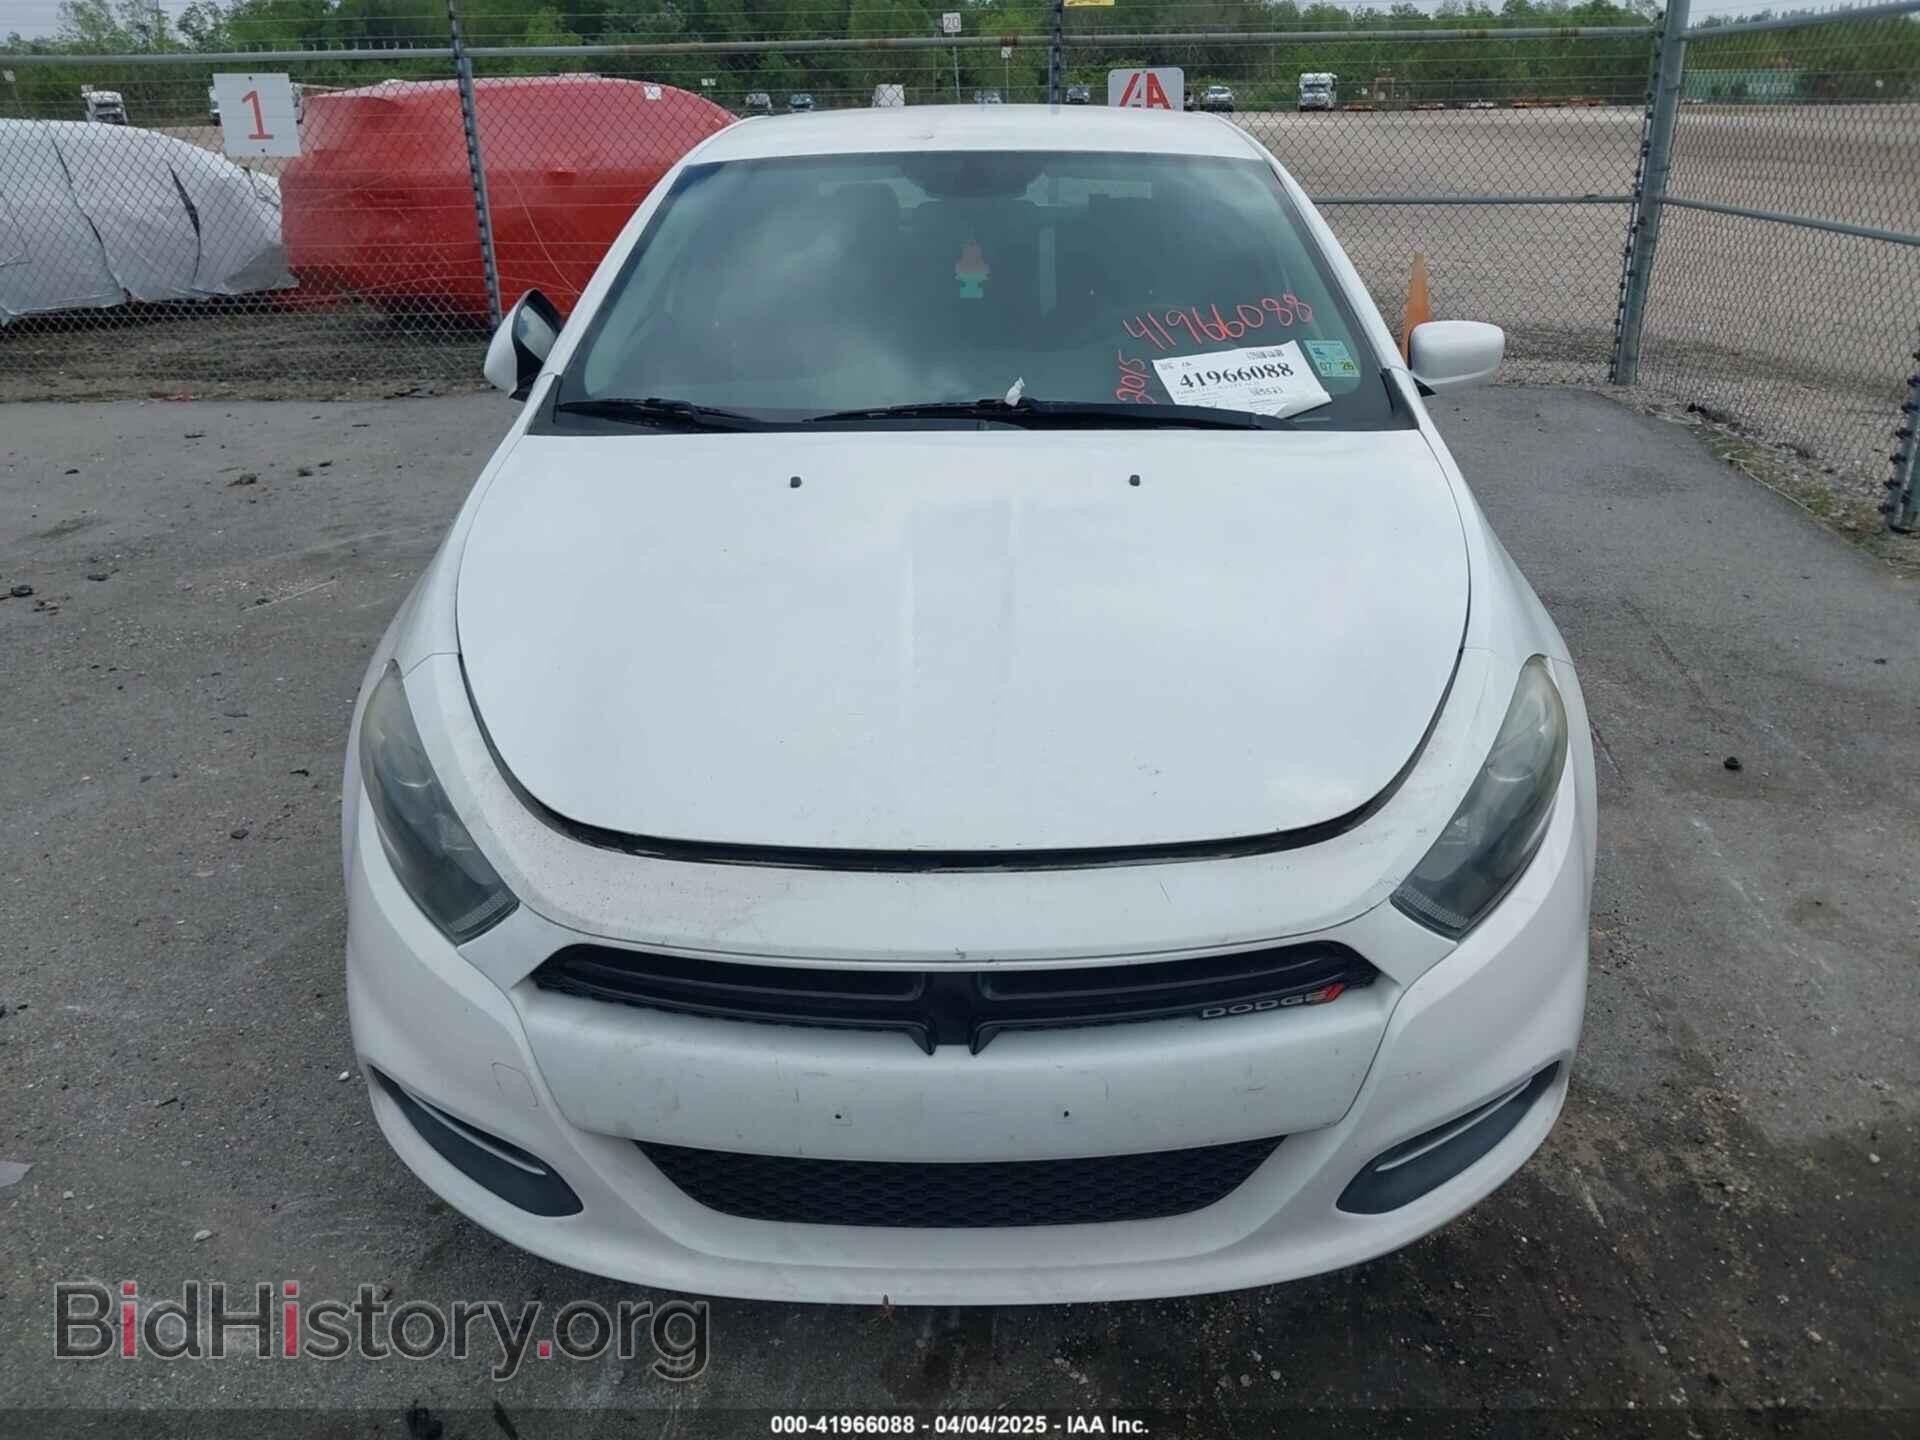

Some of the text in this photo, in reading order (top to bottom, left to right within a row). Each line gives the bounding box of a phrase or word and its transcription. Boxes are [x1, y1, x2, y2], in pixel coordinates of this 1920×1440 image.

[944, 16, 961, 31] 20
[241, 90, 275, 140] 1
[1122, 292, 1313, 350] 41966088
[1179, 361, 1295, 389] 41966088
[1202, 991, 1327, 1018] DODGE
